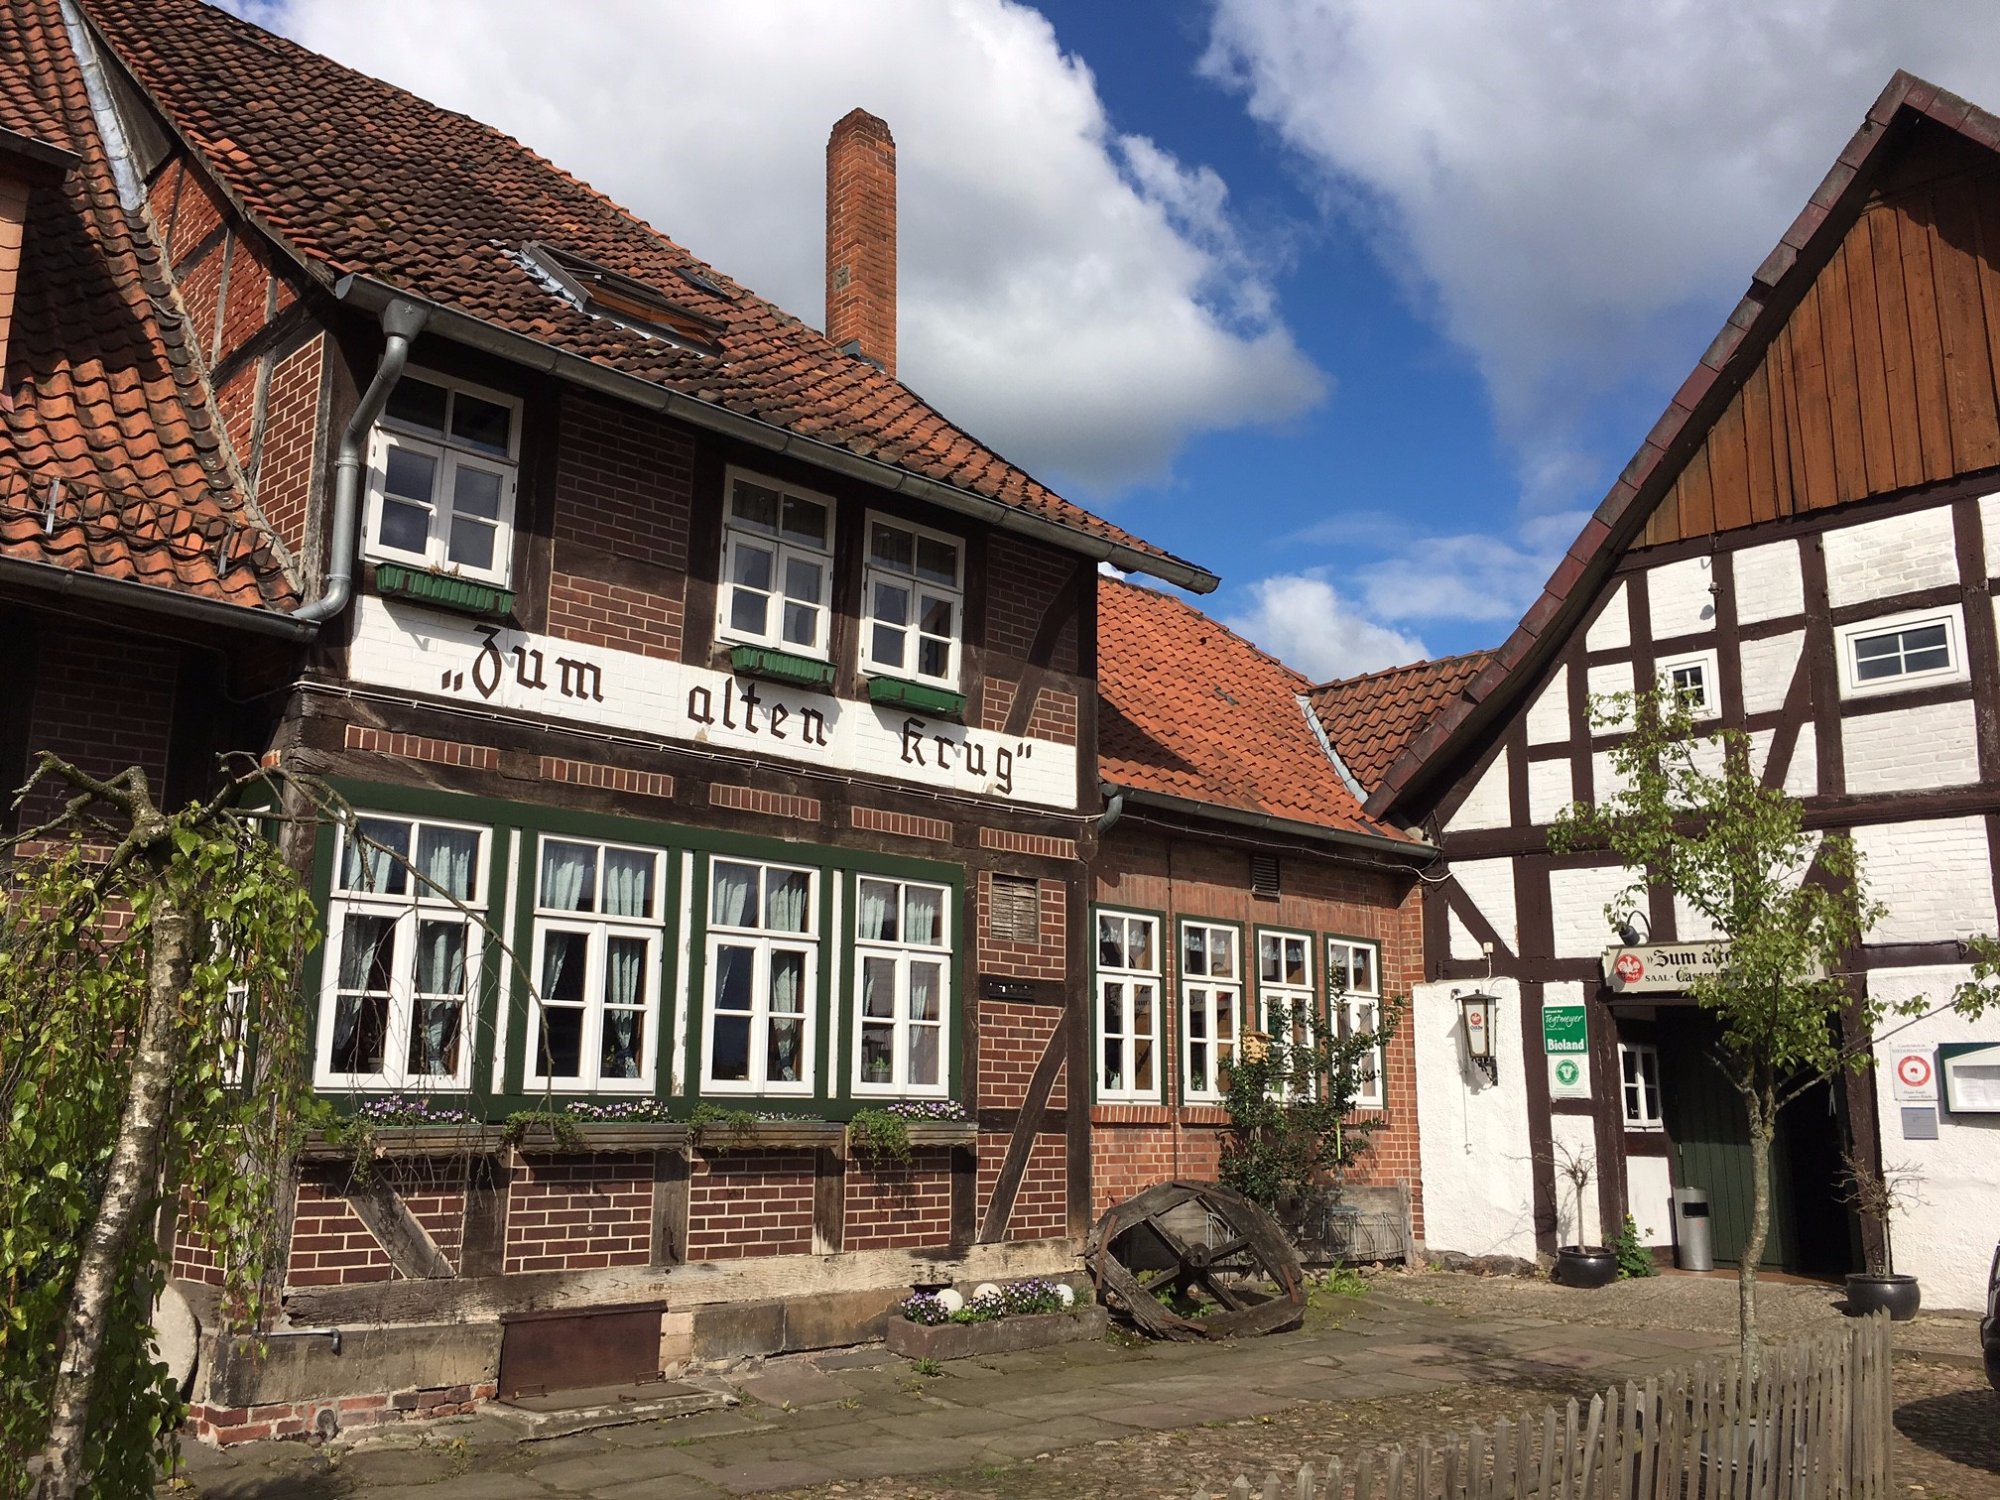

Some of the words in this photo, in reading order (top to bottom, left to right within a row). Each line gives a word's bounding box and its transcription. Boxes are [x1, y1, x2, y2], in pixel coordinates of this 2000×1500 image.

[688, 676, 827, 746] alten
[1645, 974, 1670, 982] SAAL
[1545, 1014, 1584, 1028] Tegtmeyer
[1547, 1038, 1585, 1051] Bioland
